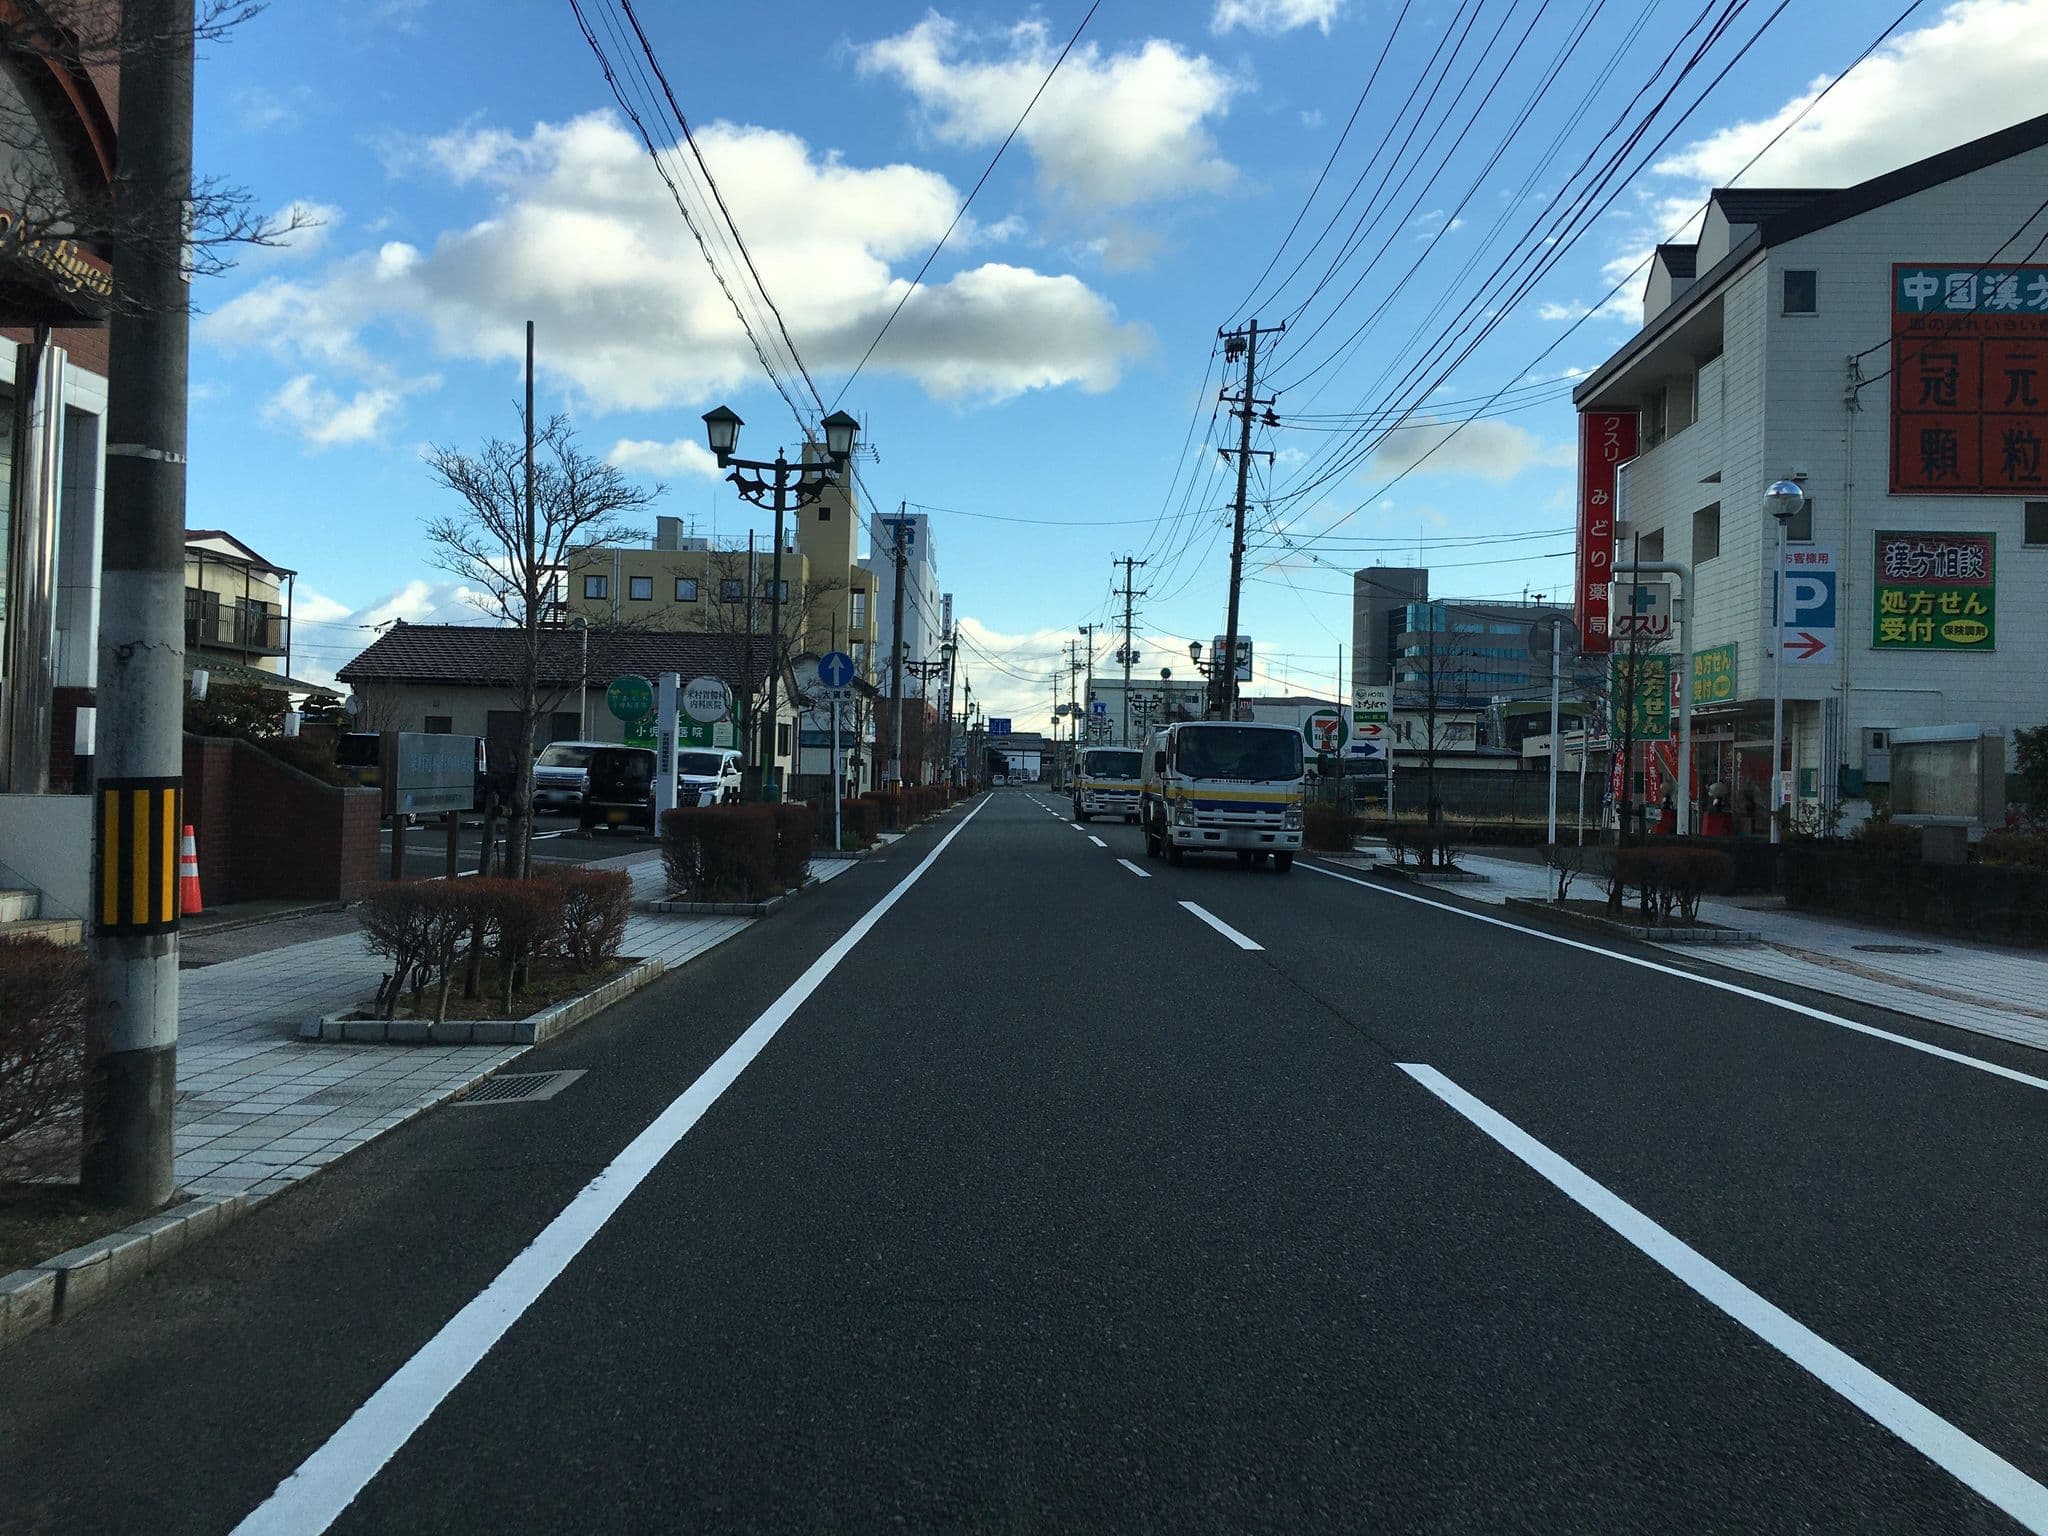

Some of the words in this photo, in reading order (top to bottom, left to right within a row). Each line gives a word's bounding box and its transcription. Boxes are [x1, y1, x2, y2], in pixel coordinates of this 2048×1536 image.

[1603, 415, 1621, 463] クスリ
[1588, 488, 1610, 635] みどり薬局
[1884, 541, 1986, 580] 漢方相談
[1783, 577, 1828, 623] P
[1880, 589, 1988, 616] 処方せん
[1615, 614, 1669, 635] クスリ
[1880, 616, 1935, 643] 受付
[1695, 648, 1731, 676] 処方せん
[1641, 658, 1666, 735] 処方せん
